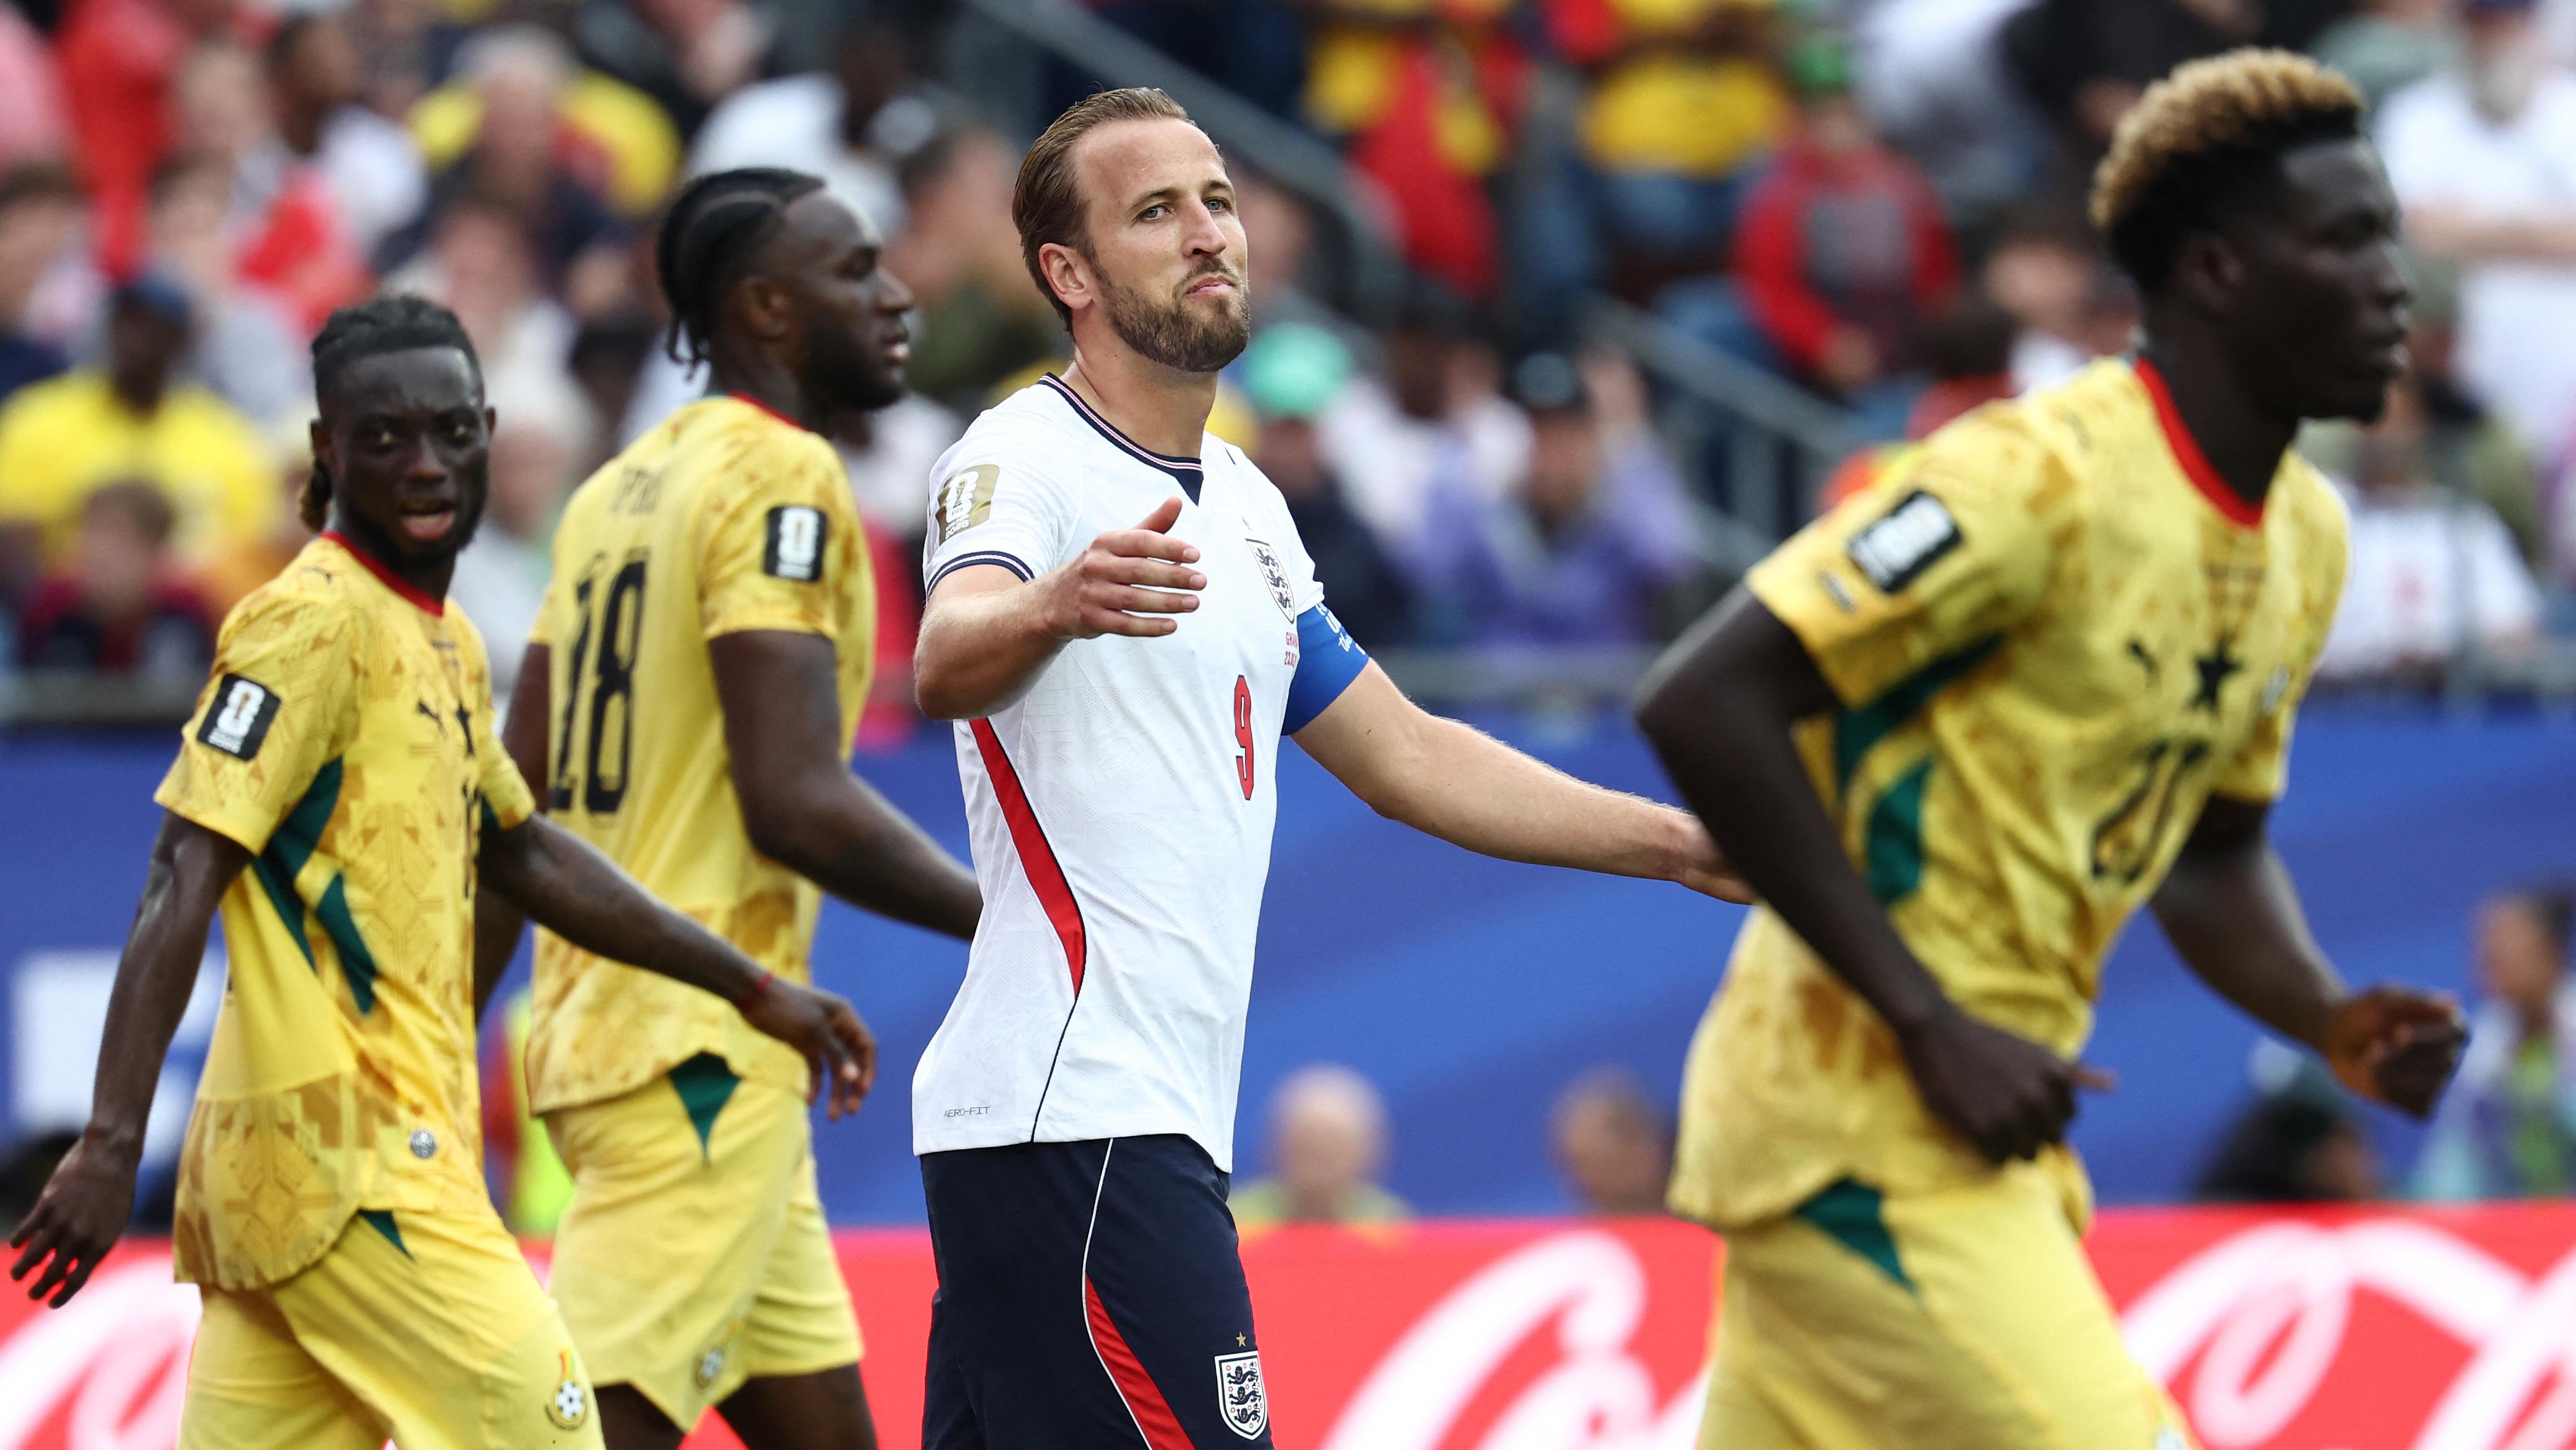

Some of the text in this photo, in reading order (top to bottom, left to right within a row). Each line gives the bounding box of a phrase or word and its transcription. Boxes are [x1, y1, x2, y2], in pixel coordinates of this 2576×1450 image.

[952, 507, 963, 516] FIFA
[945, 519, 969, 539] 2026
[550, 551, 649, 814] 18
[1234, 674, 1254, 801] 9
[943, 1106, 991, 1117] AERO-FIT
